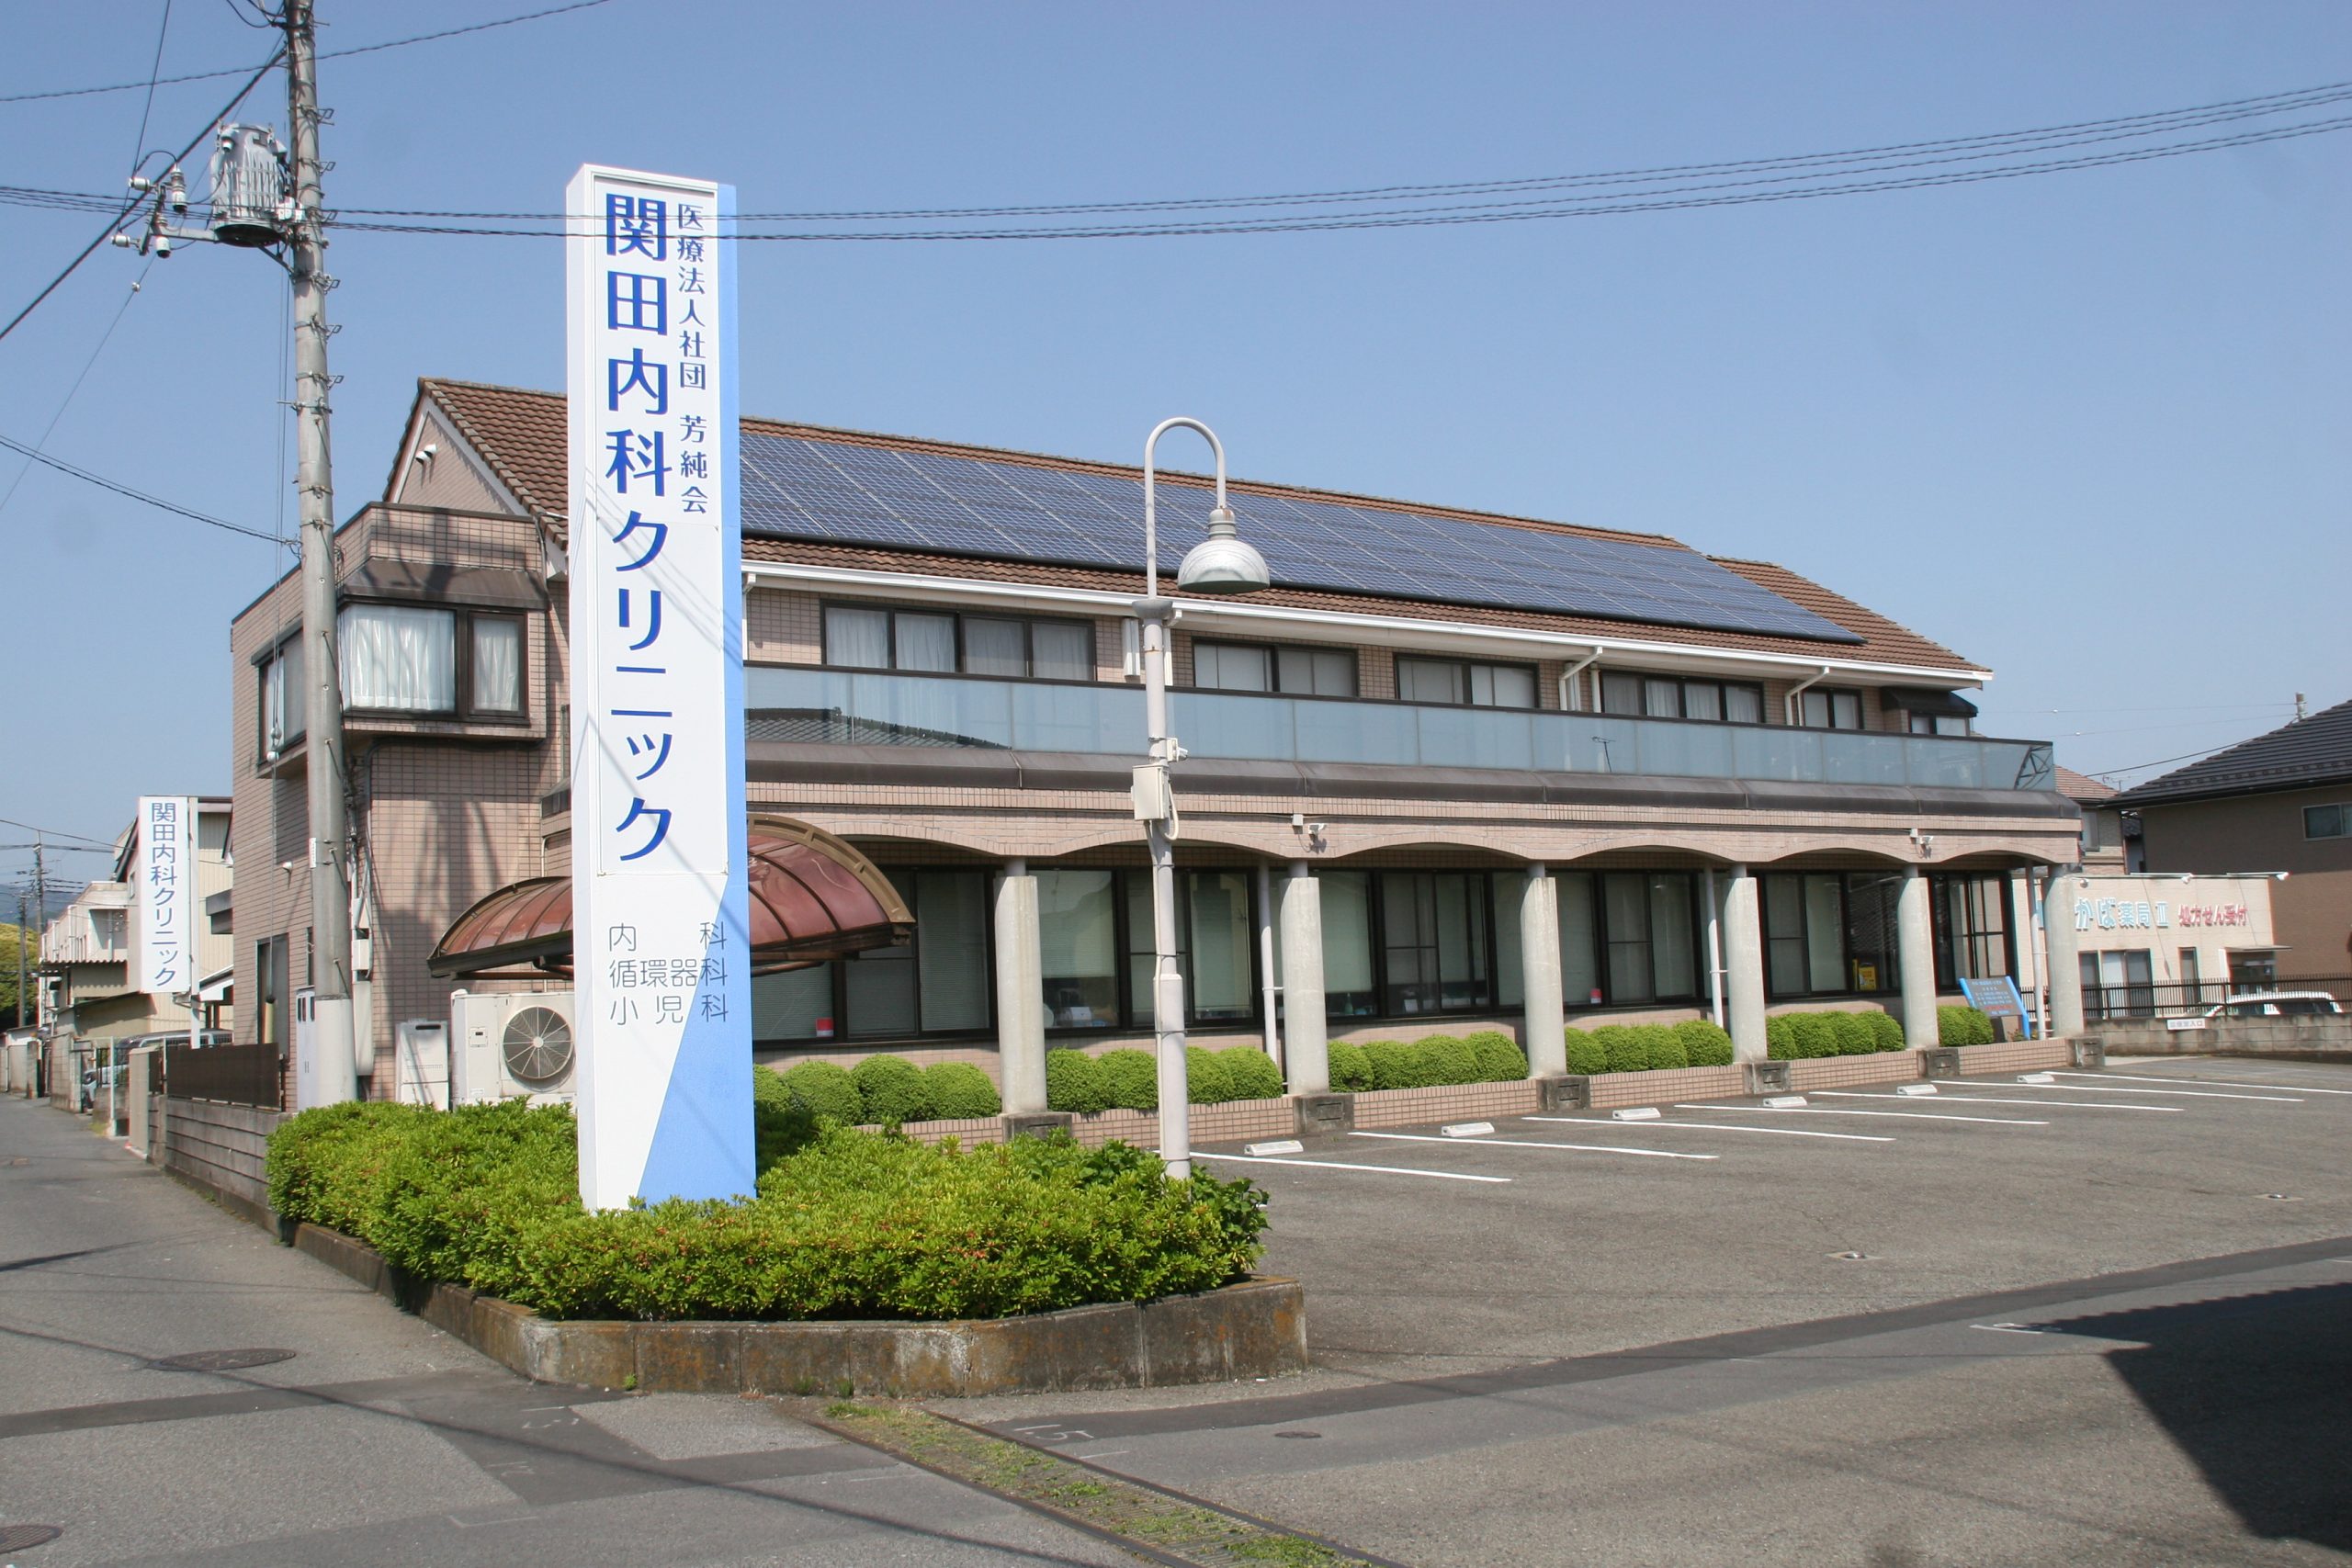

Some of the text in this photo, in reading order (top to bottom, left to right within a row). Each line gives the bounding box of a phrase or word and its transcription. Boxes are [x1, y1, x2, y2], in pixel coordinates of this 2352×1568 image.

[677, 203, 708, 514] 医療法人社団 芳純会
[605, 193, 673, 862] 関田内科クリニック
[151, 802, 178, 987] 関田内科クリニック
[609, 957, 729, 988] 循環器科
[2177, 904, 2248, 928] 処方せん受付
